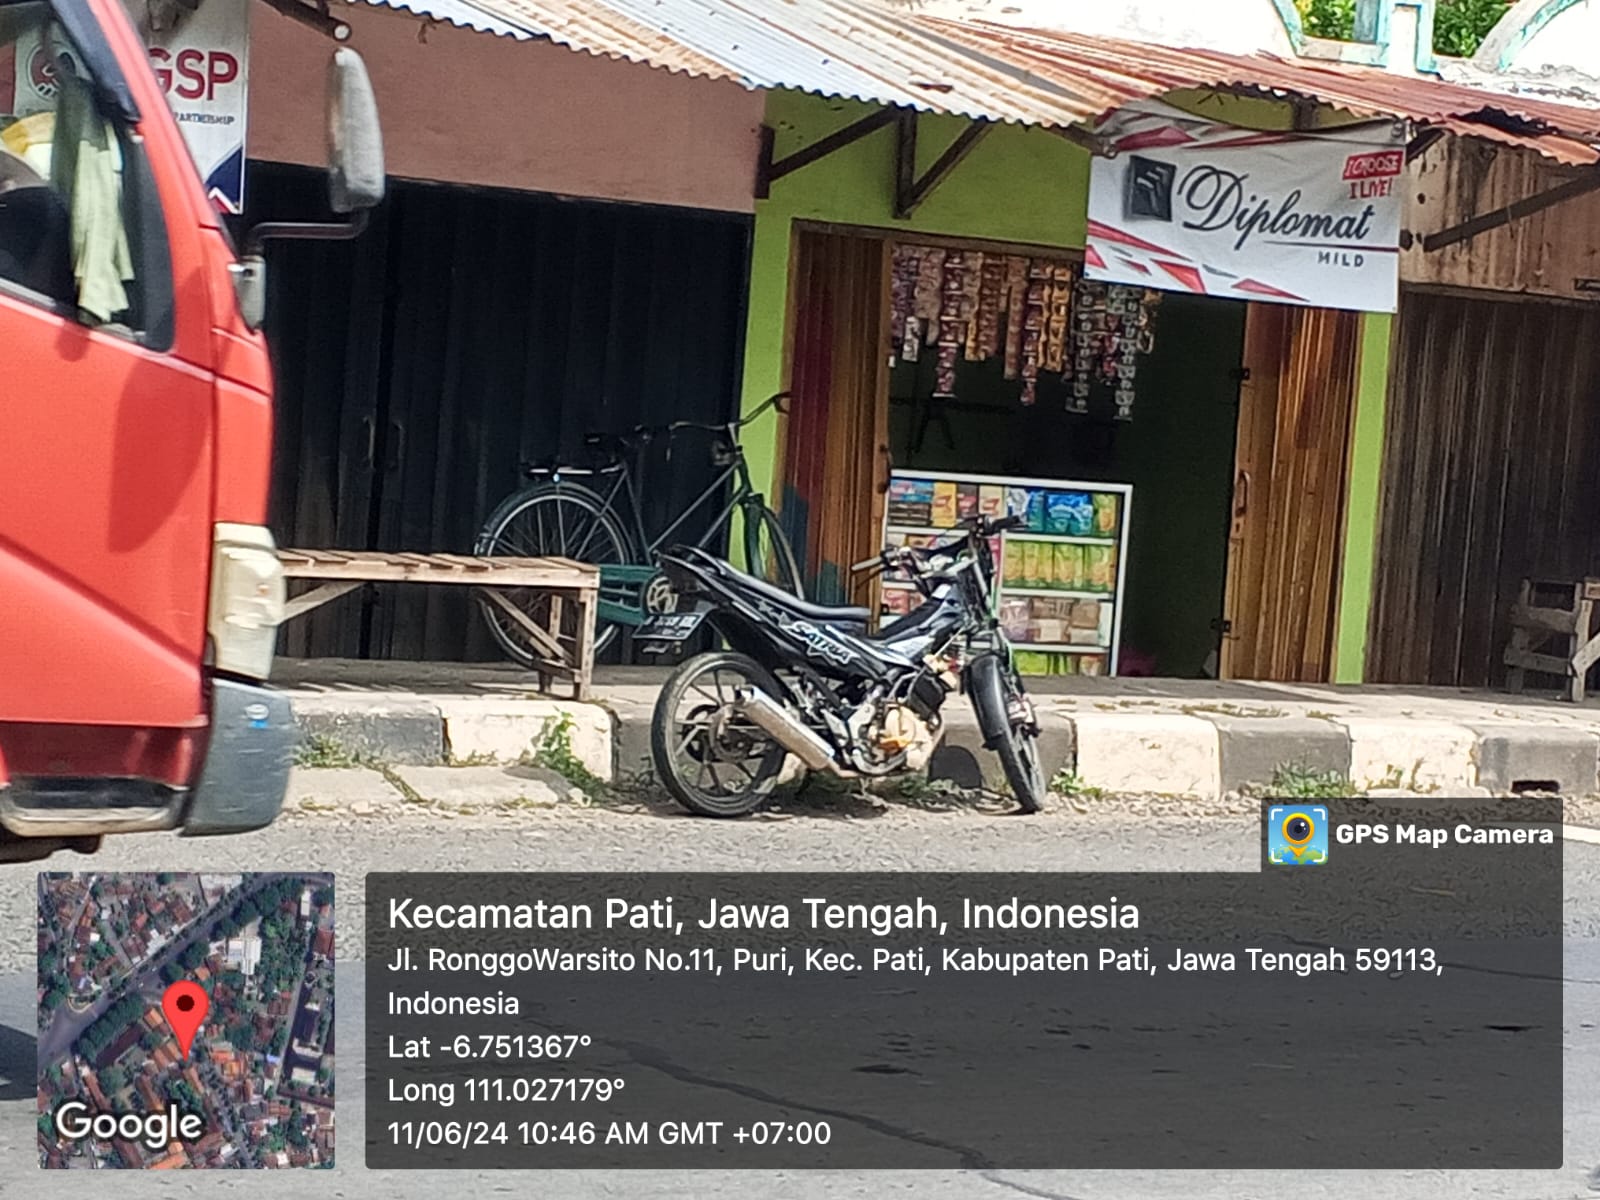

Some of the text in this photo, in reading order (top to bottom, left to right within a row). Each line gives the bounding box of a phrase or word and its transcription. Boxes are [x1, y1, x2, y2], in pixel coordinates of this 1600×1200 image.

[1349, 177, 1393, 200] I LIVE!
[1177, 164, 1375, 251] Diplomat
[1317, 251, 1364, 268] MILD
